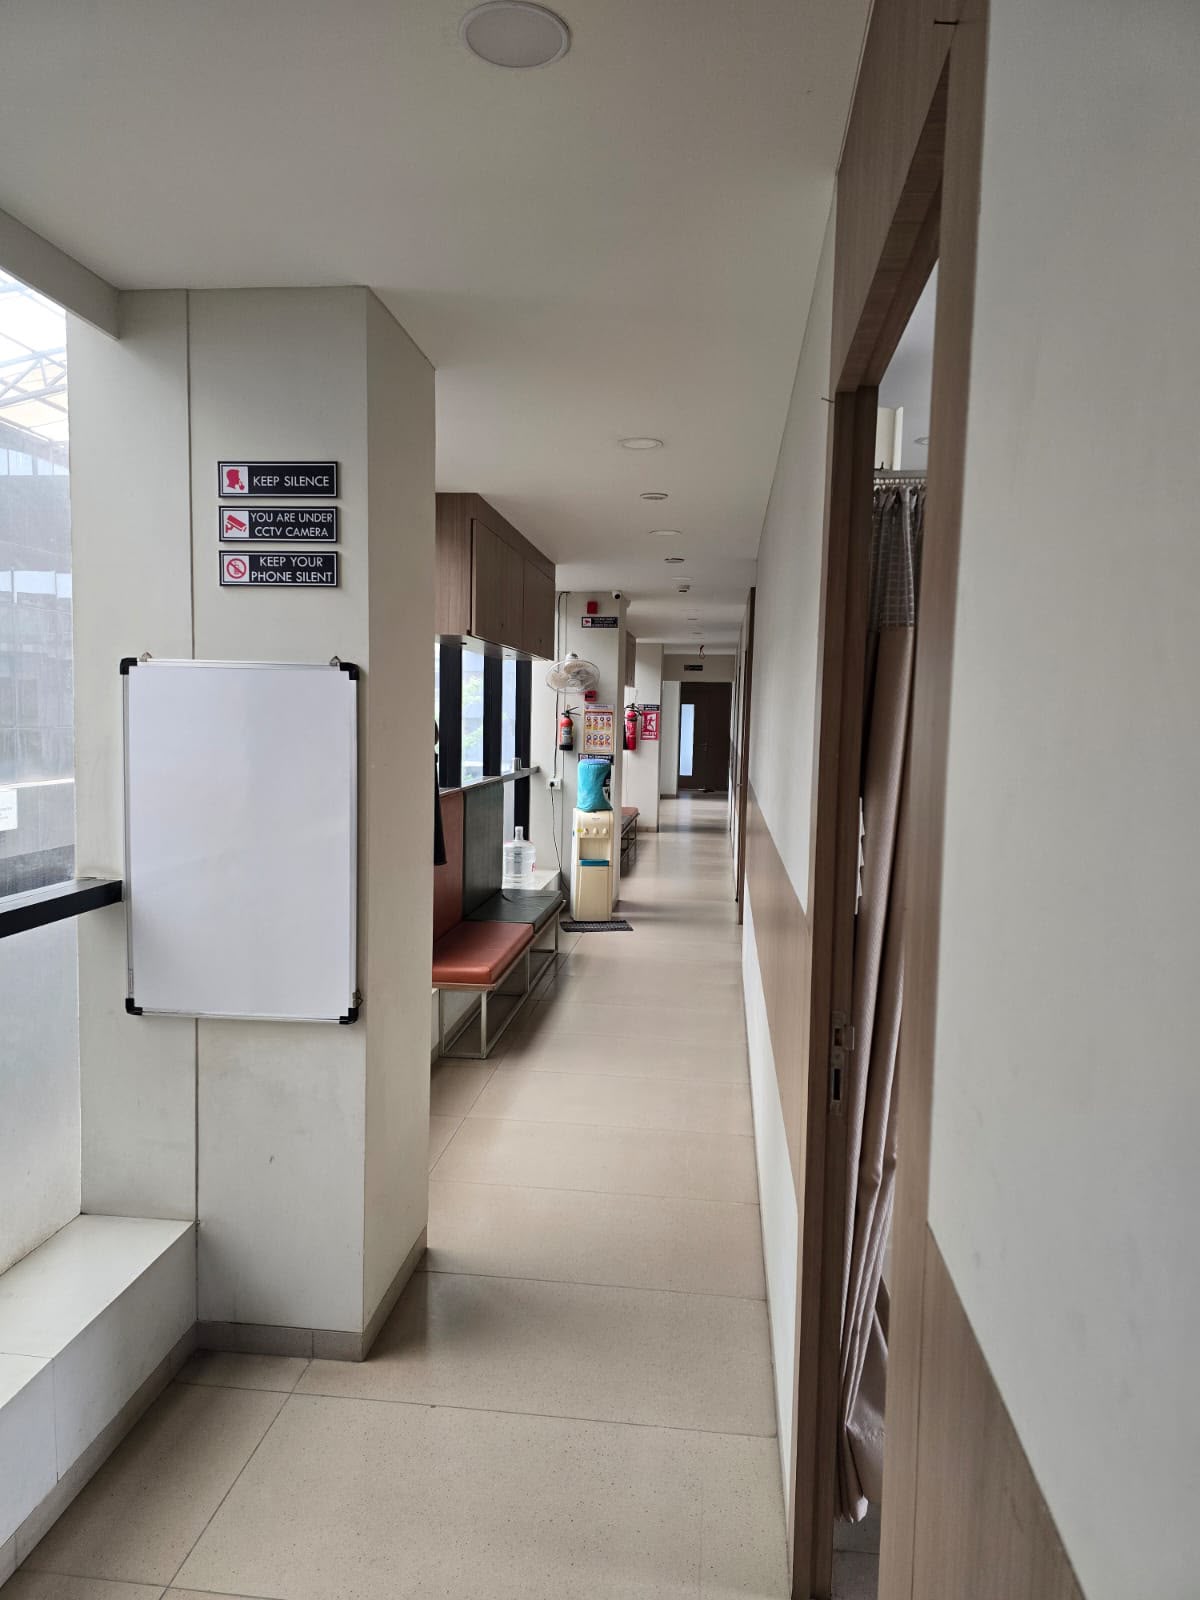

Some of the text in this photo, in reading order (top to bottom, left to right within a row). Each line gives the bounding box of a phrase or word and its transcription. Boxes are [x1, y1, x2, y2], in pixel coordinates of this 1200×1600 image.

[253, 476, 330, 487] KEEP SILENCE
[250, 513, 333, 523] YOU ARE UNDER
[254, 526, 329, 537] CCTV CAMERA
[259, 557, 323, 567] KEEP YOUR
[251, 571, 333, 582] PHONE SILENT
